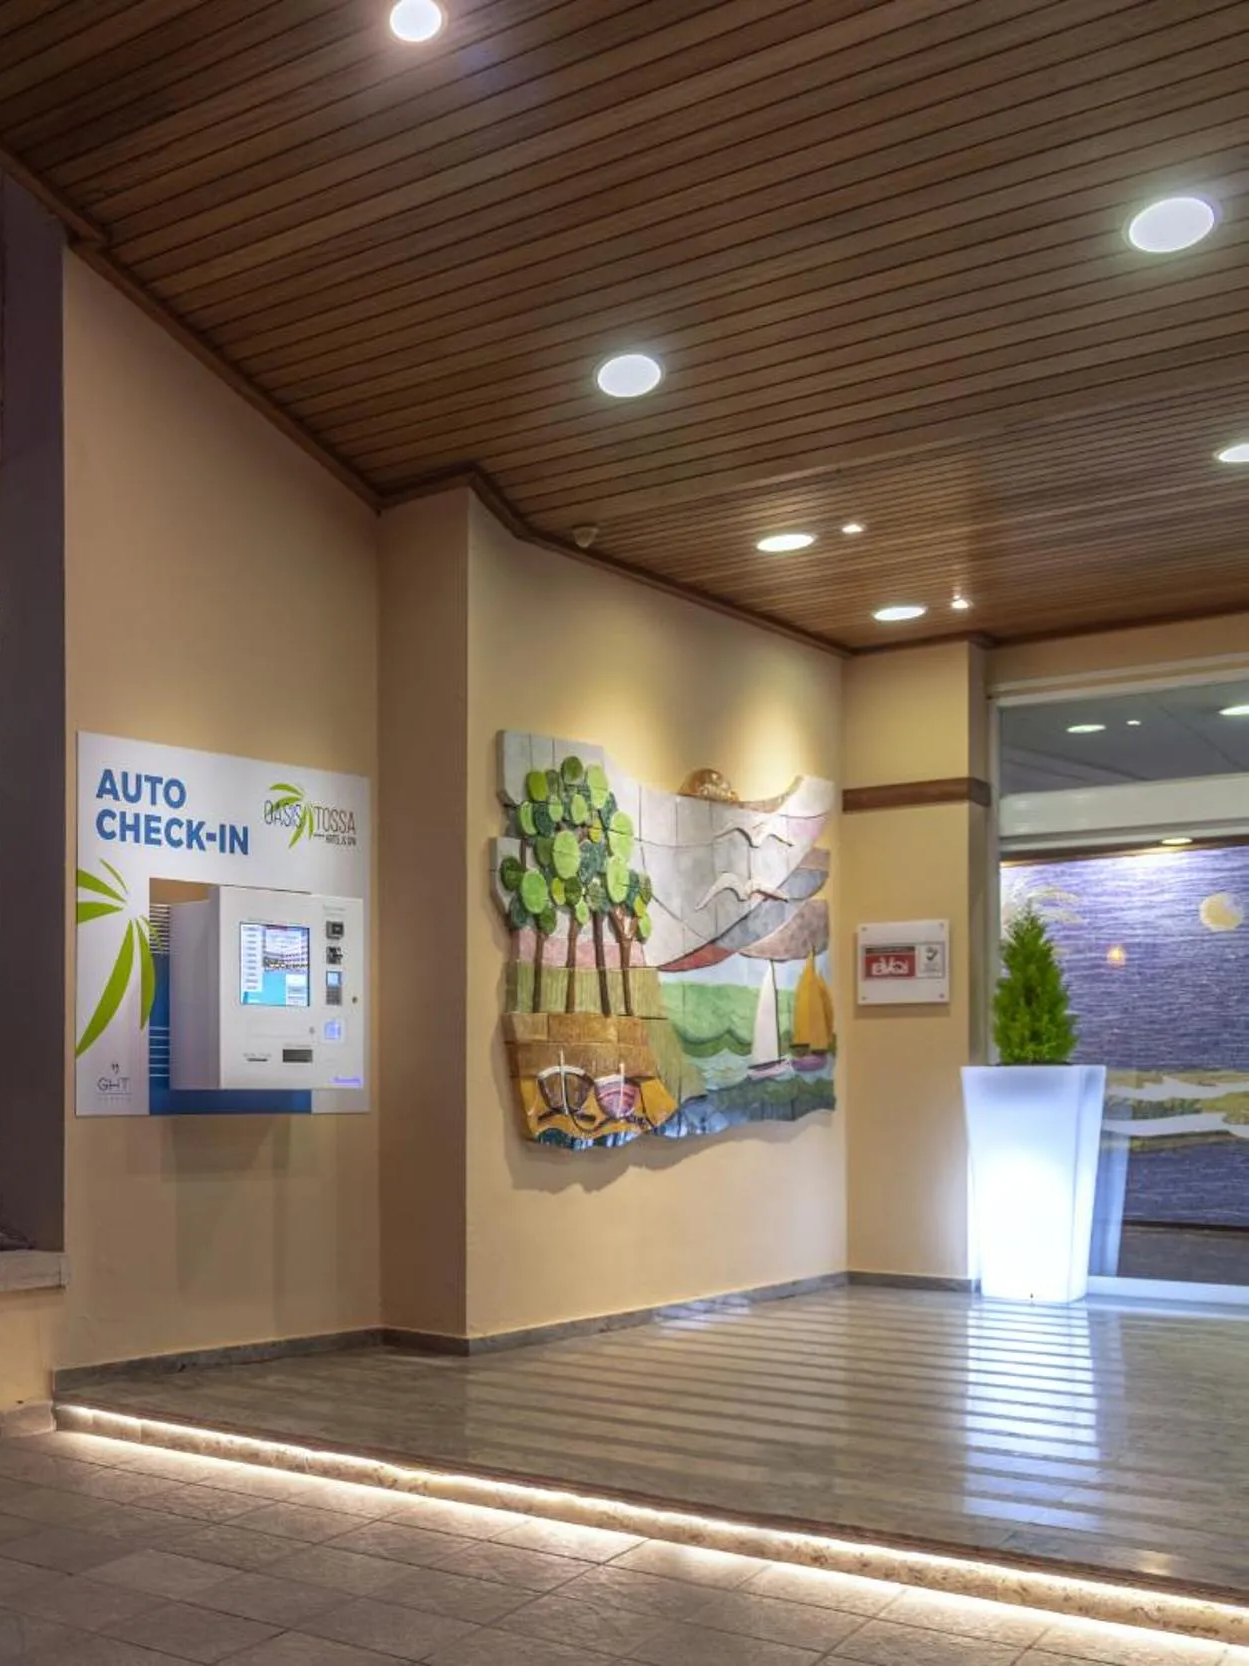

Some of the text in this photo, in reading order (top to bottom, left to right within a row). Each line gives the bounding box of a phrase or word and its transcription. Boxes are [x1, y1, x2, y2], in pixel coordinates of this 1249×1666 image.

[96, 768, 187, 809] AUTO
[95, 808, 249, 855] CHECK-IN
[314, 805, 356, 835] TOSSA
